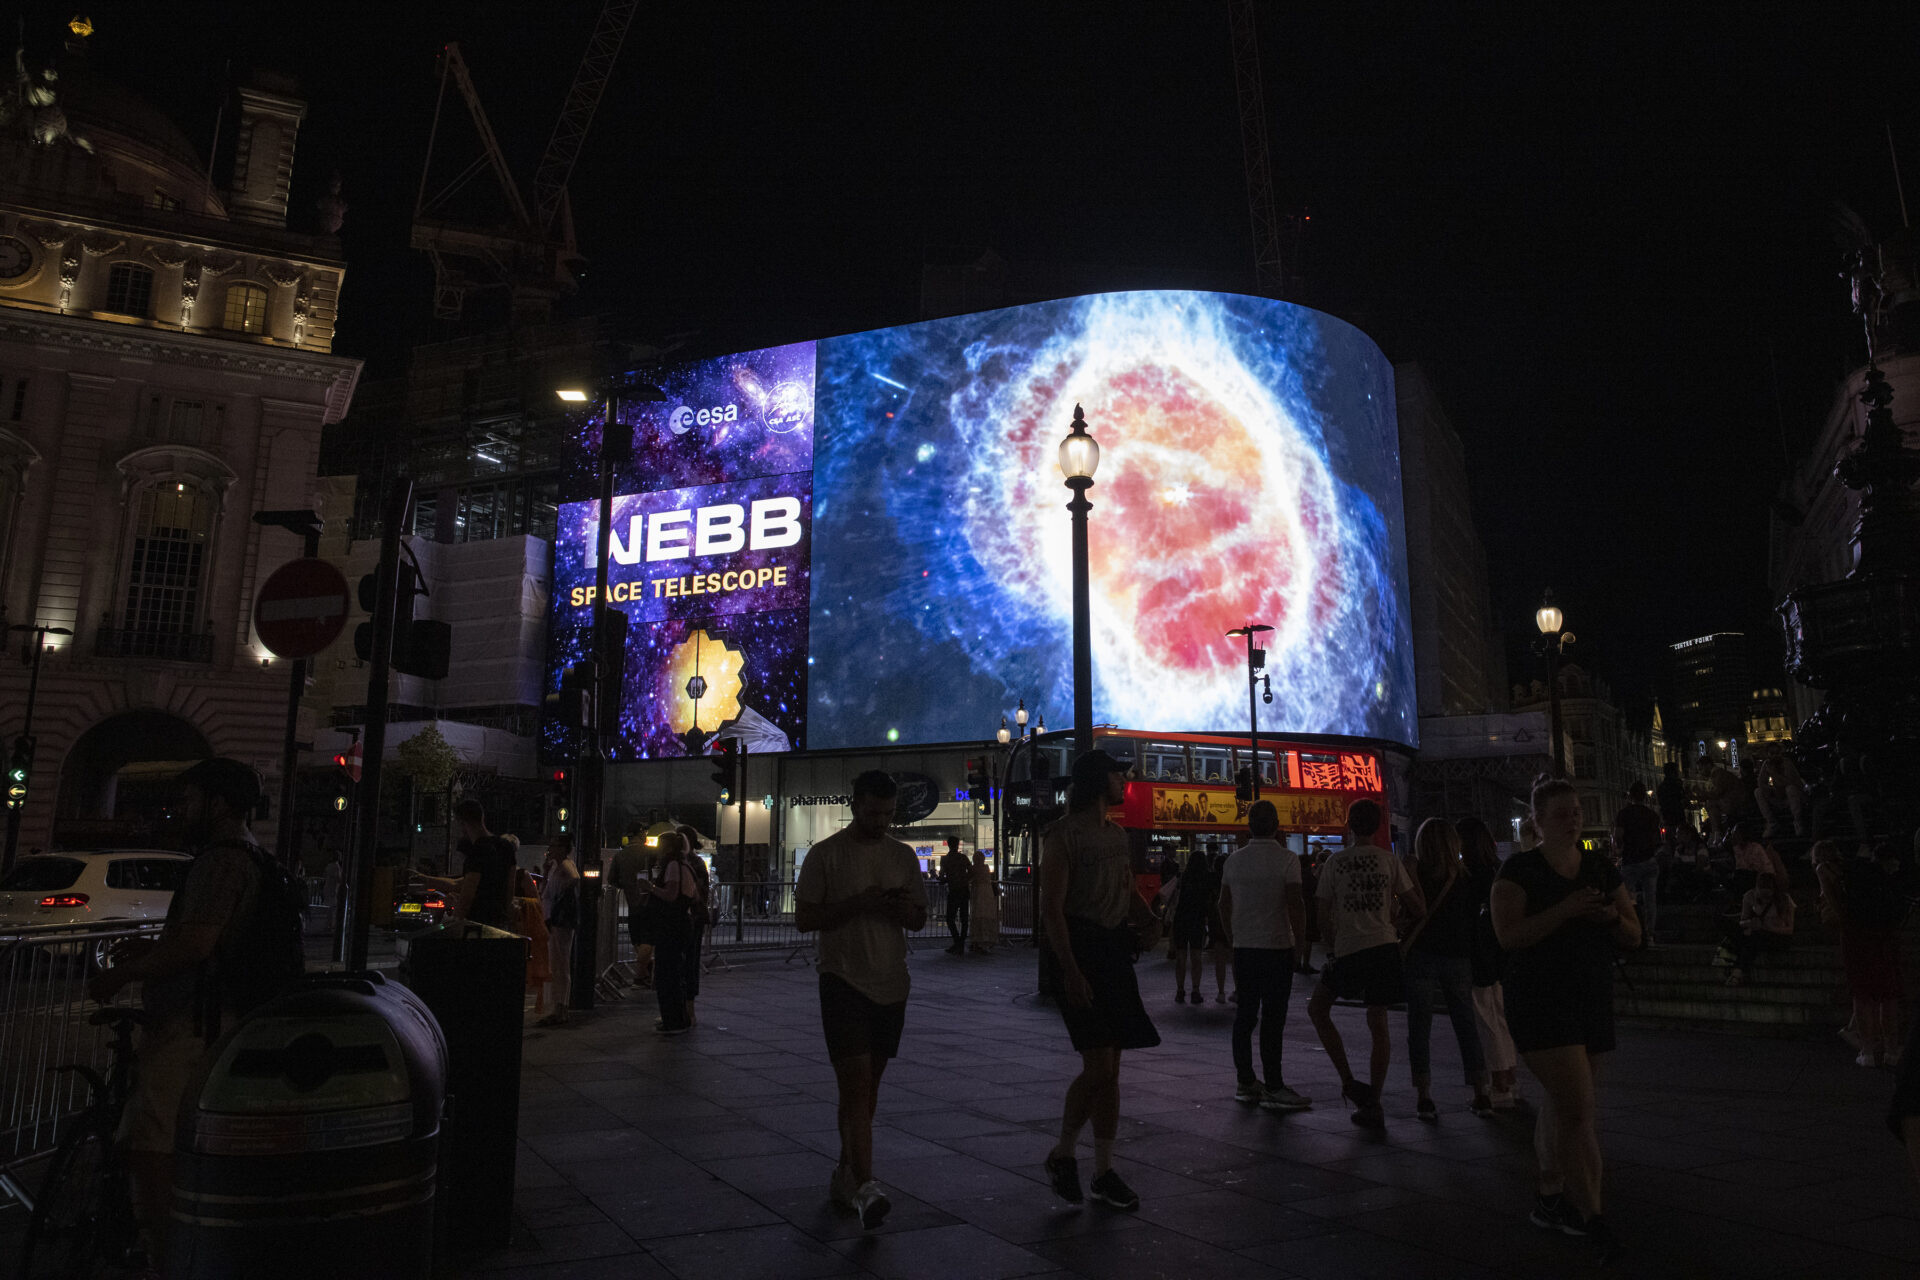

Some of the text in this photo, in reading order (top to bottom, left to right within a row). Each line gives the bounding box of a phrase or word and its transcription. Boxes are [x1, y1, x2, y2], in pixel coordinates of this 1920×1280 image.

[696, 404, 738, 426] esa
[651, 566, 787, 598] TELESCOPE
[1694, 634, 1713, 645] POINT
[790, 794, 853, 809] pharmacy
[1055, 790, 1066, 805] 14
[583, 870, 600, 878] WAIT
